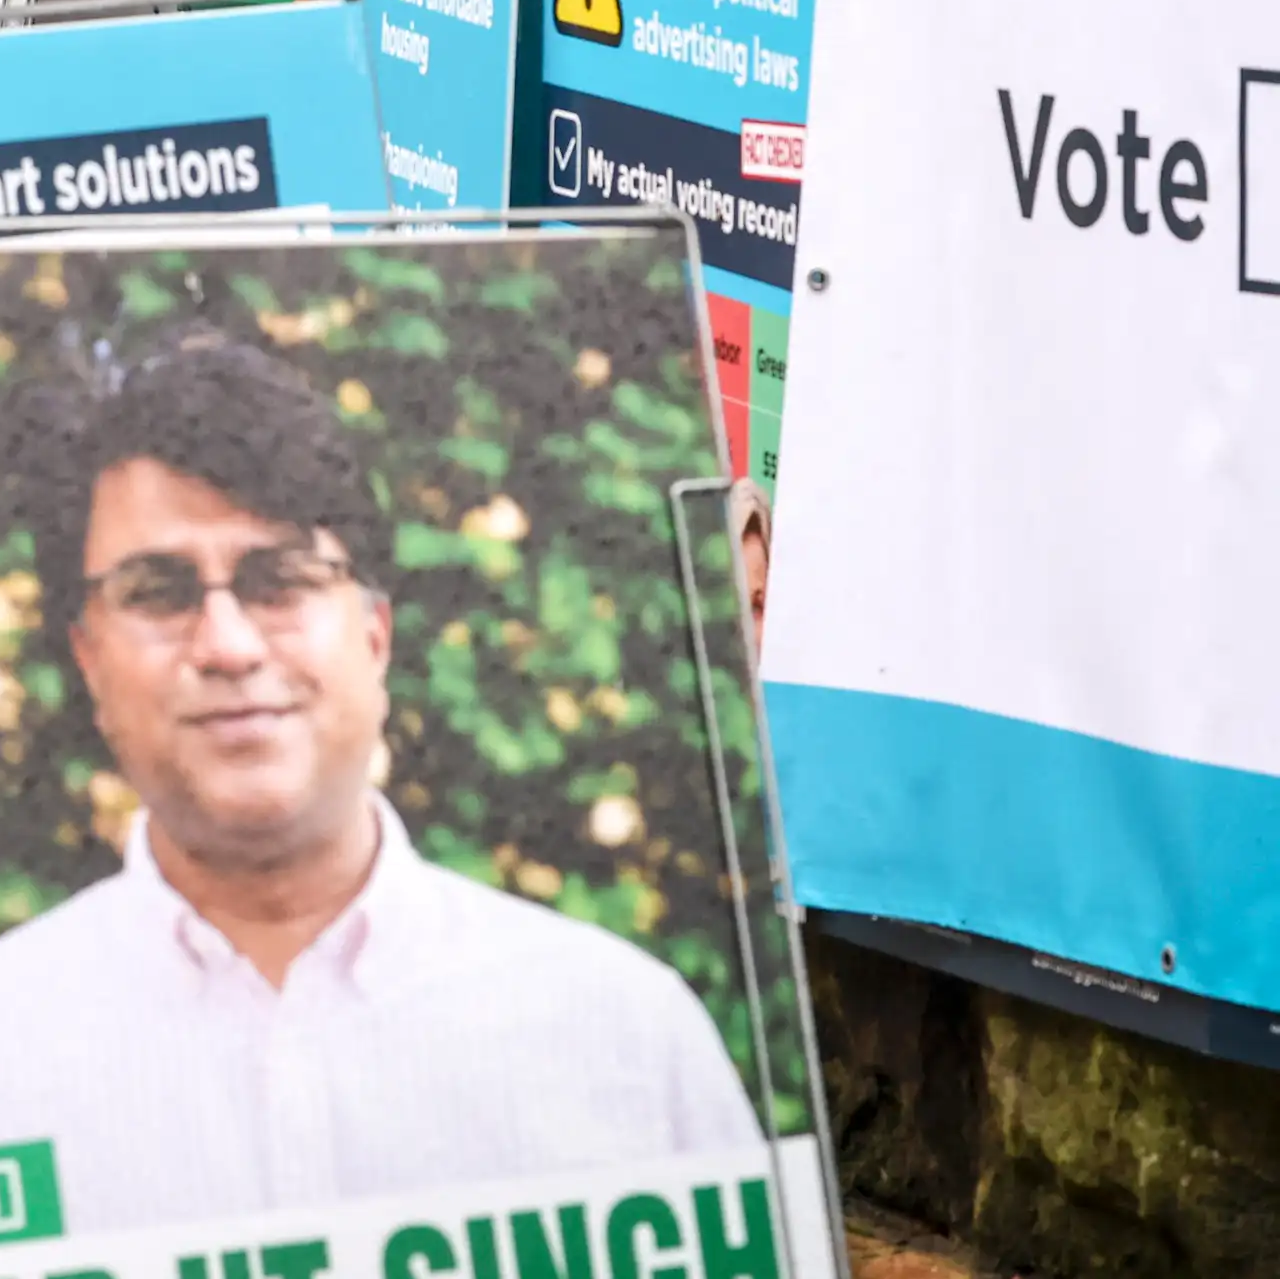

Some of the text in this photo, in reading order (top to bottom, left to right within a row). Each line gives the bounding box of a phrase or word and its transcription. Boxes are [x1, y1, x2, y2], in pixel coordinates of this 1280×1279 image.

[381, 11, 430, 76] housing
[633, 10, 799, 92] advertising laws
[54, 137, 262, 212] solutions
[381, 130, 458, 207] hampioning
[587, 147, 798, 247] My actual voting record
[997, 87, 1209, 242] Vote
